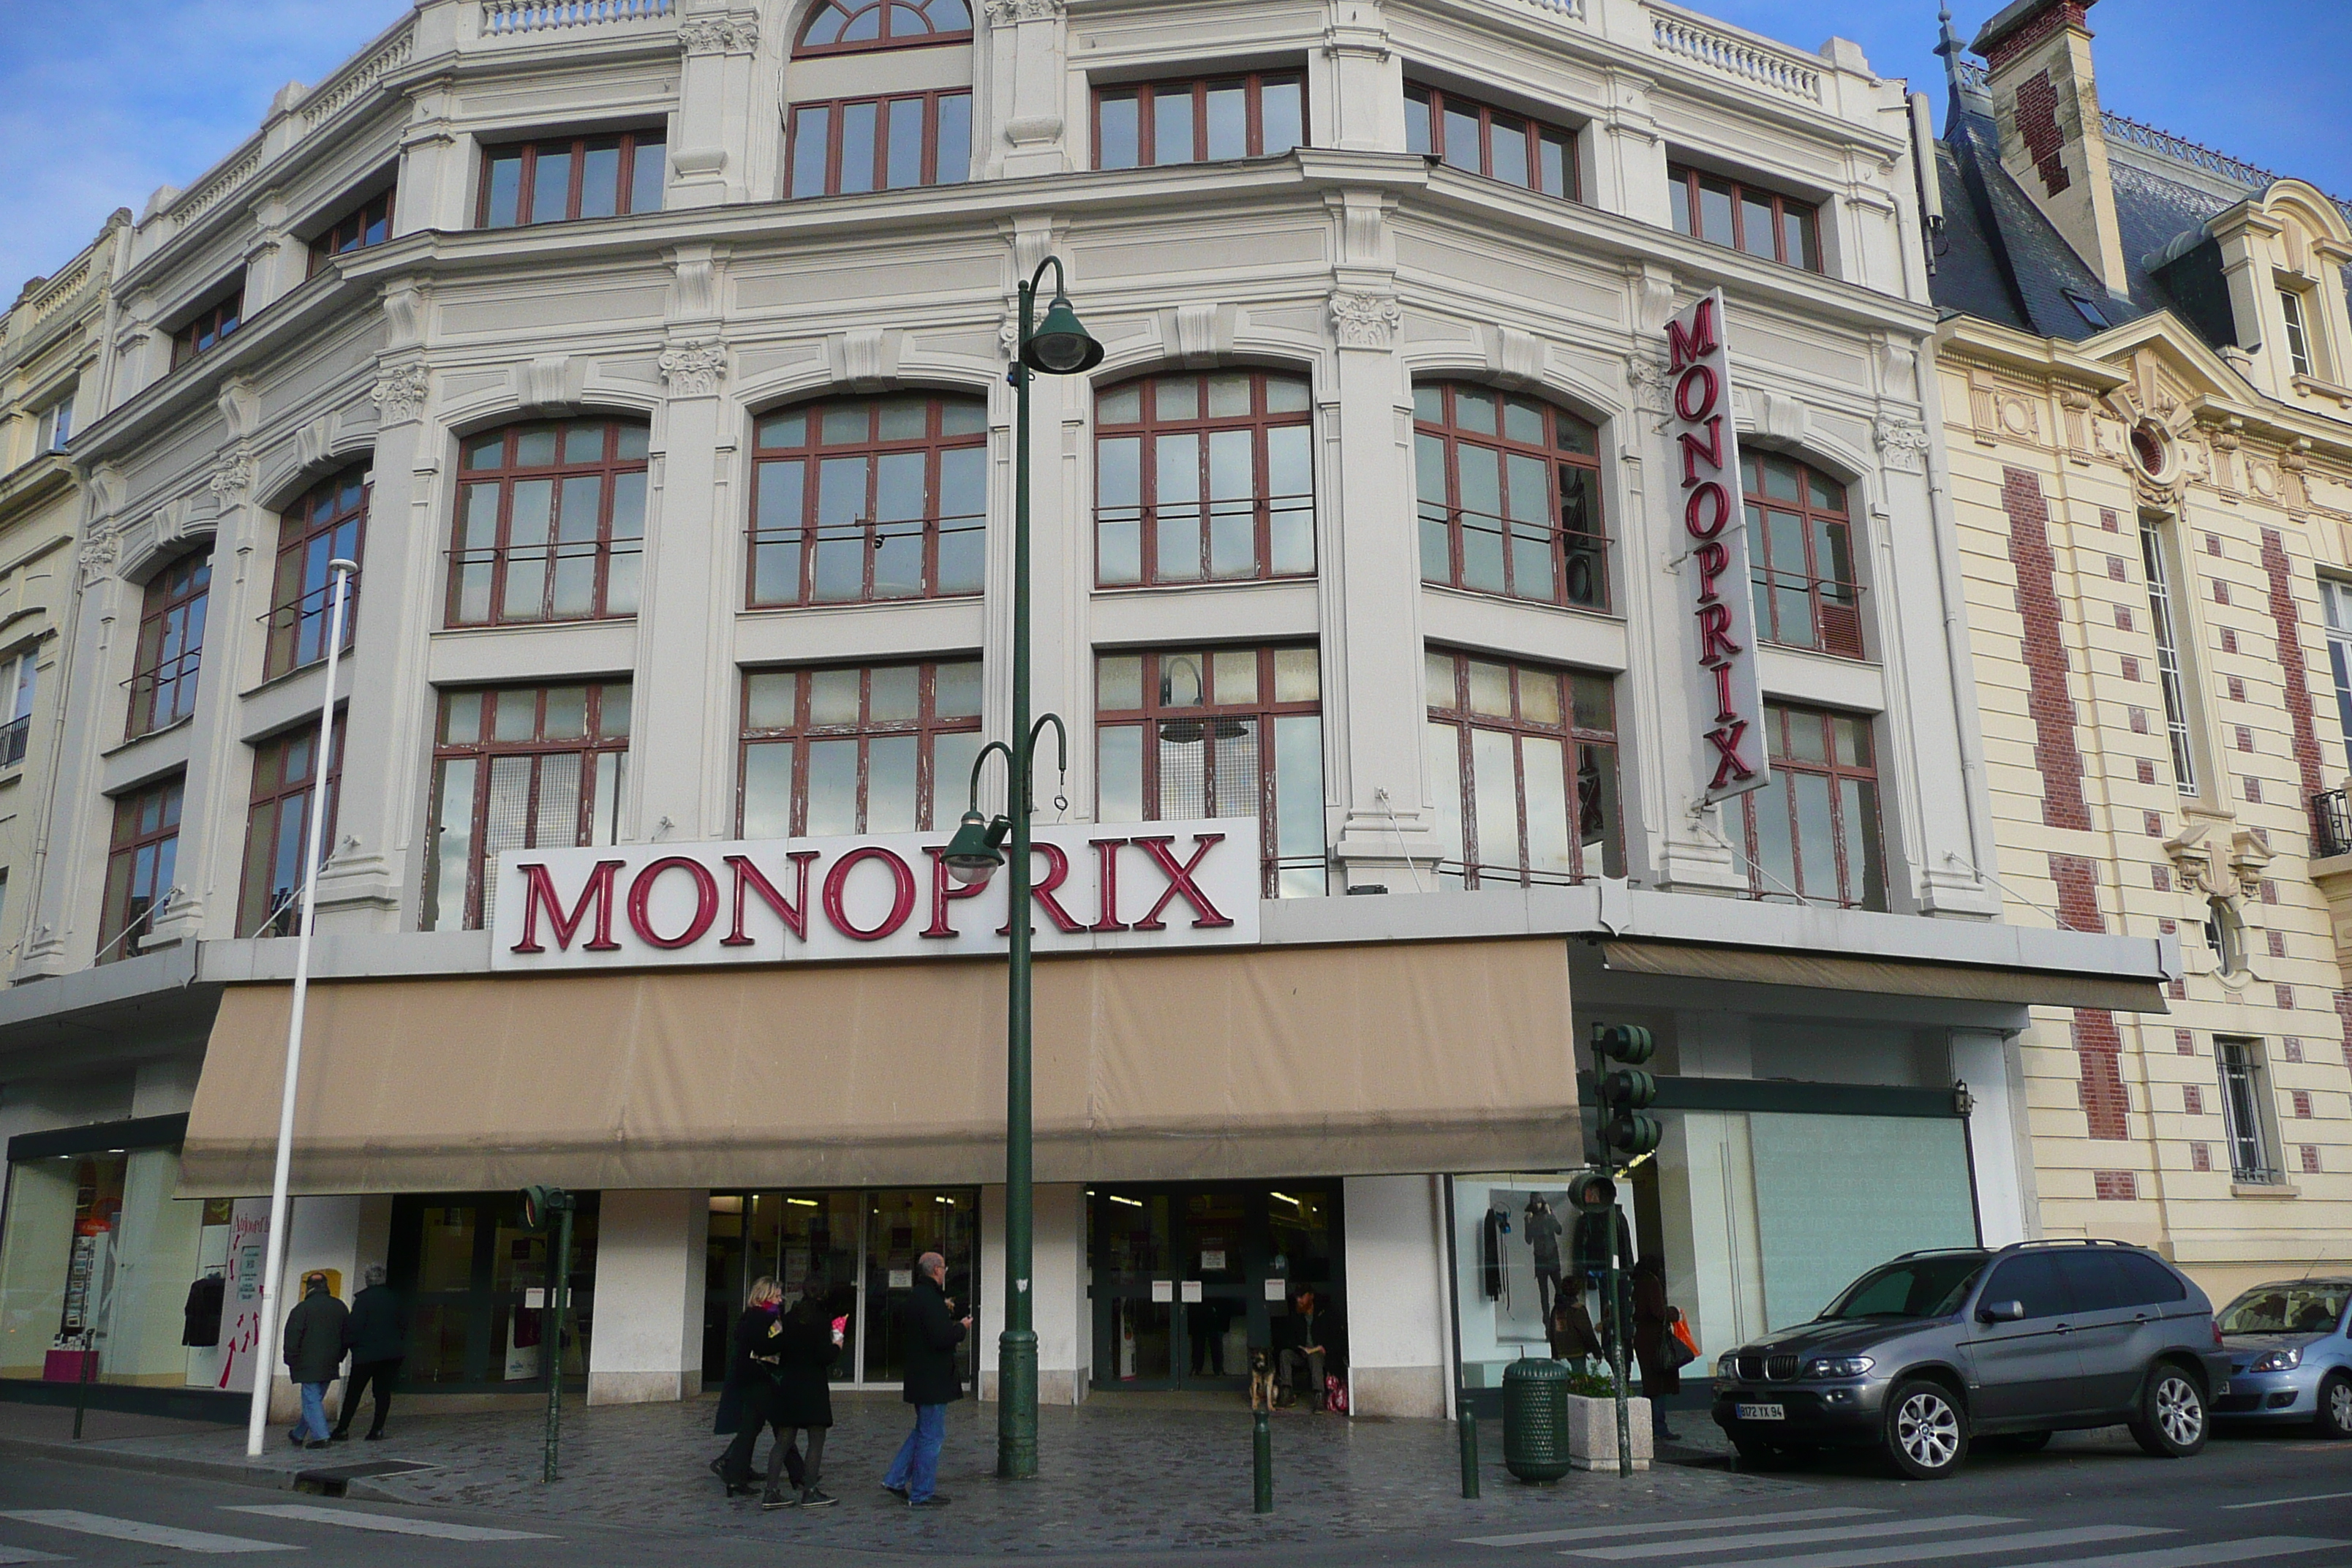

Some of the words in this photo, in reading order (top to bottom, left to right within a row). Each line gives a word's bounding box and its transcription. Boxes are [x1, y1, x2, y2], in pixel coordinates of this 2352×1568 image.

[1663, 297, 1754, 789] MONOPRIX
[510, 833, 1234, 953] MONOPRIX
[1758, 1406, 1769, 1417] YX
[1771, 1406, 1782, 1417] 94
